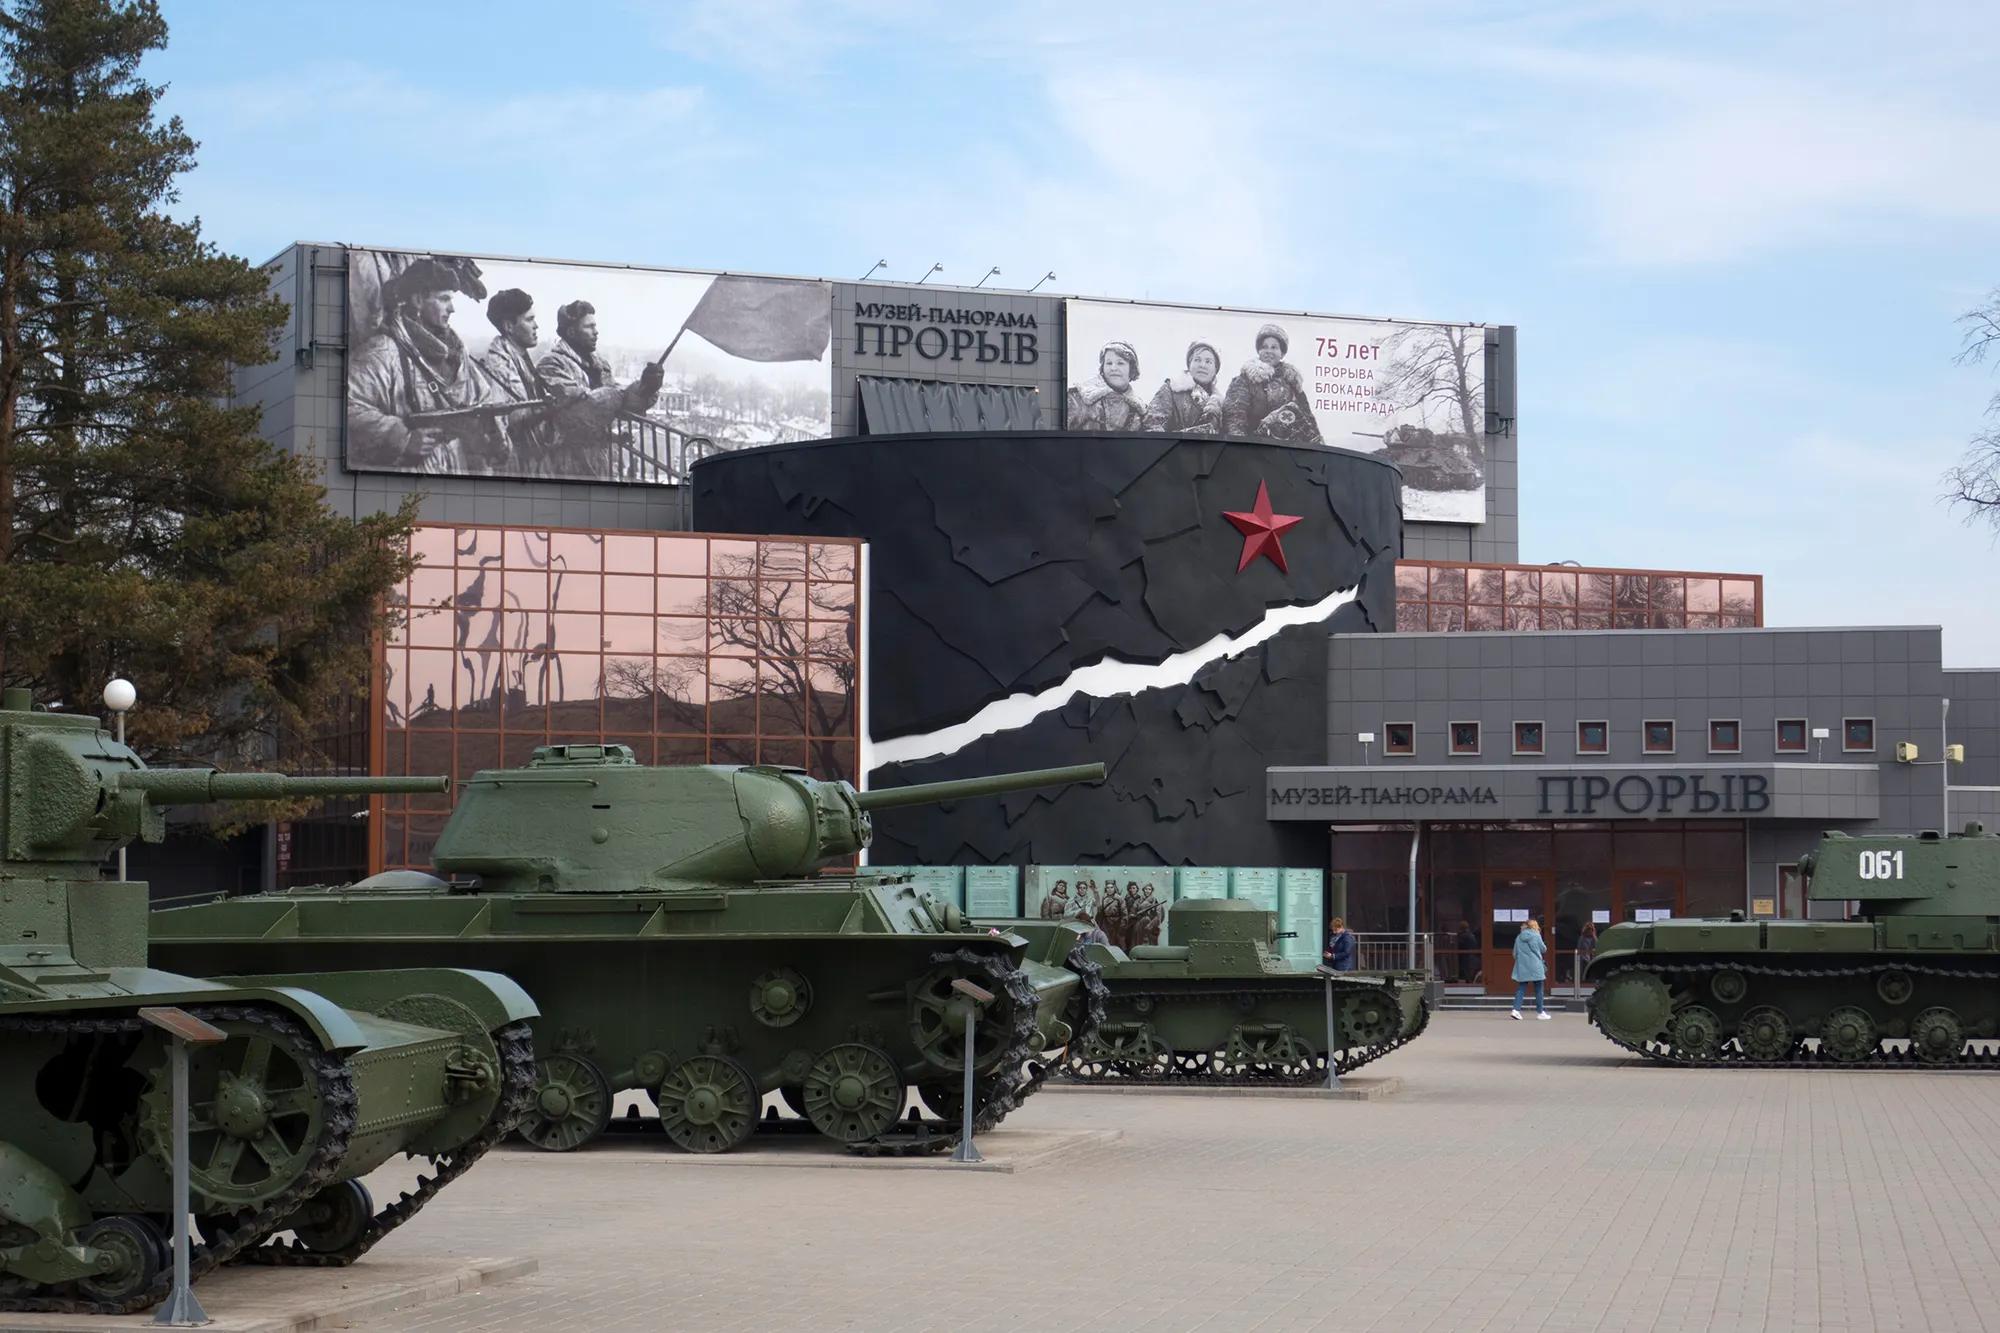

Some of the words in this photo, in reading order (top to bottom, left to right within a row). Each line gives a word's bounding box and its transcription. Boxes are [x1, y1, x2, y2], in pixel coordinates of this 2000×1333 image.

[855, 302, 1038, 329] МУЗЕЙ-ПАНОРАМА
[854, 322, 1039, 365] ПРОРЫВ
[1315, 337, 1338, 358] 75
[1345, 344, 1380, 360] лет
[1315, 366, 1374, 380] ПРОРЫВА
[1315, 382, 1374, 398] БЛОКАДЫ
[1315, 399, 1395, 416] ЛЕНИНГРАДА
[1271, 786, 1498, 806] МУЗЕЙ-ПАНОРАМА
[1537, 774, 1771, 814] ПРОРЫВ
[1859, 850, 1904, 880] 061
